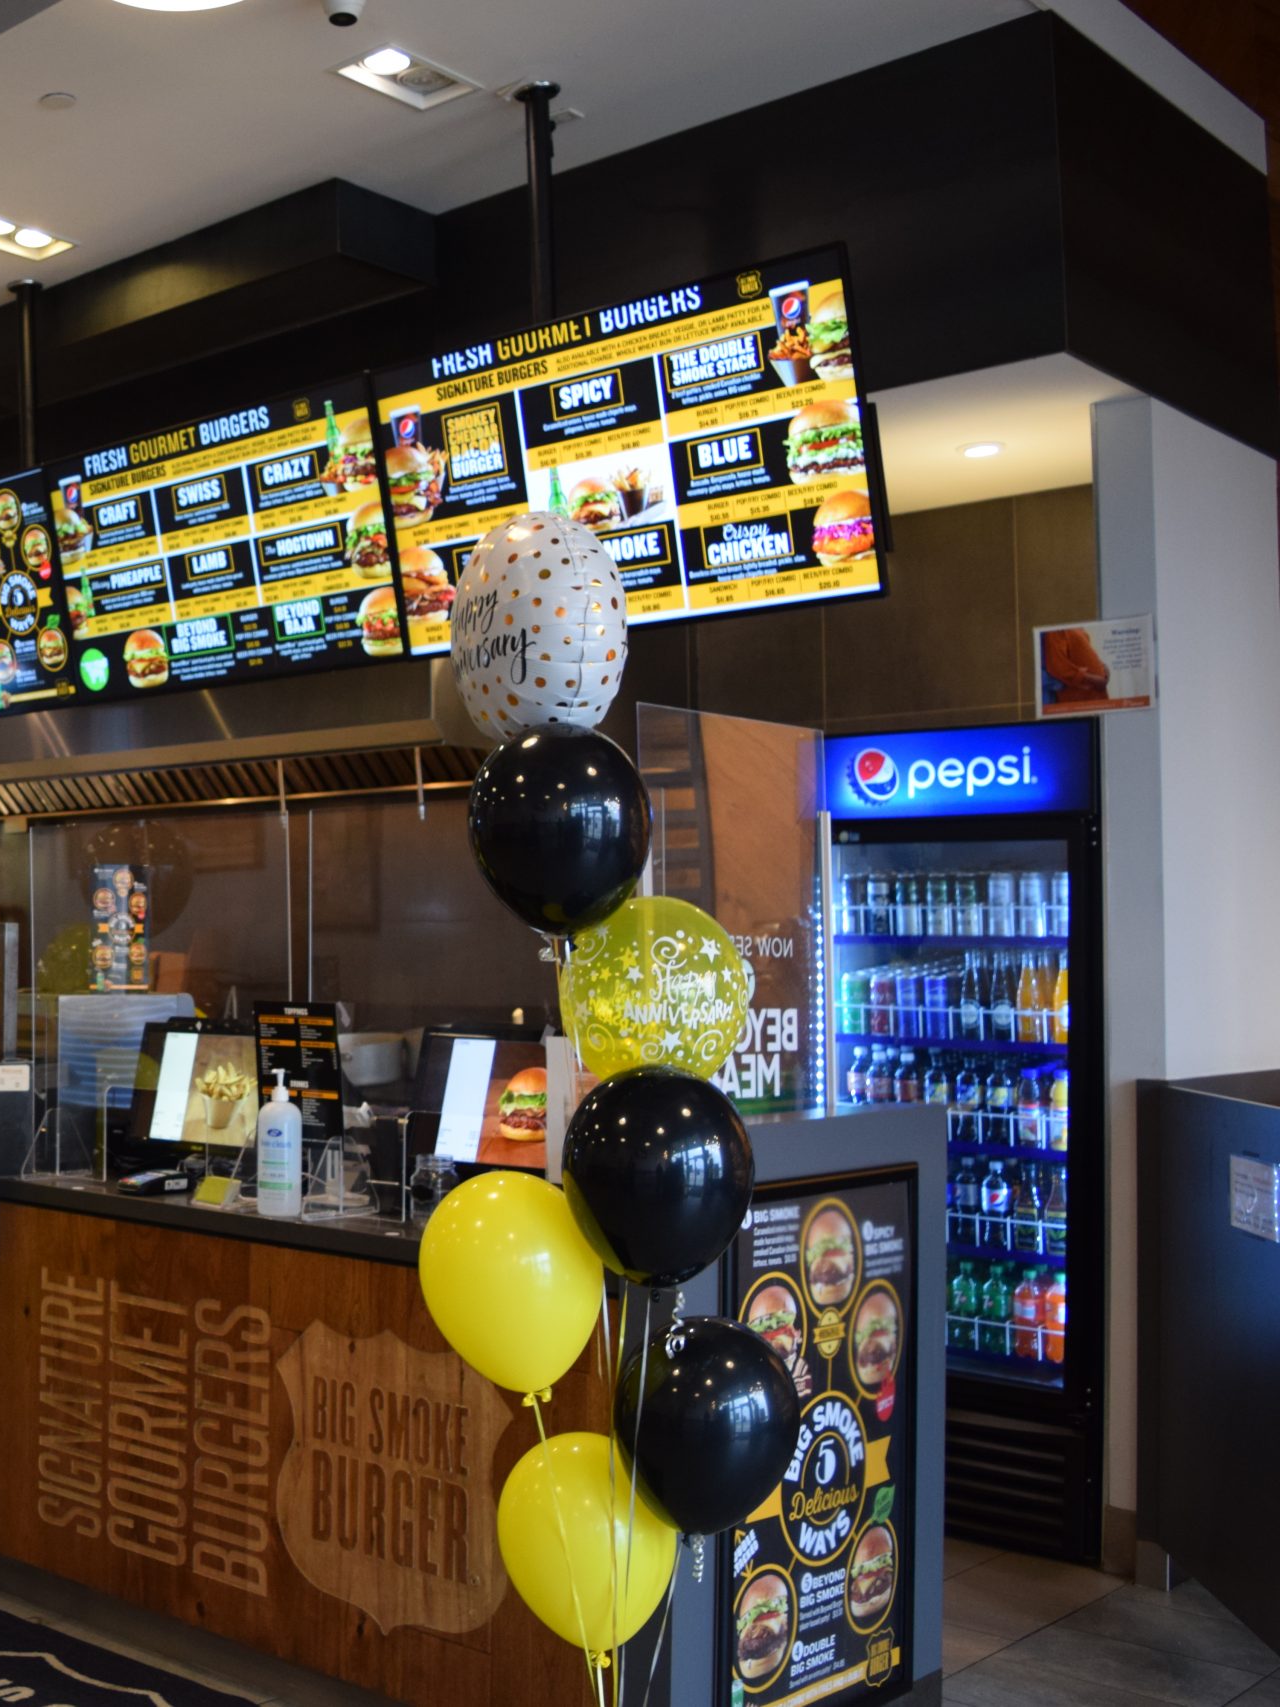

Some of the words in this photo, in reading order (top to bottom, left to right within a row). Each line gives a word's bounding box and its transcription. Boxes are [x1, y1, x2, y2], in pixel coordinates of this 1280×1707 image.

[431, 343, 493, 379] FRESH
[497, 316, 592, 360] GOURMET
[599, 286, 702, 334] BURGERS
[670, 352, 699, 371] THE
[700, 335, 755, 365] DOUBLE
[436, 374, 495, 401] SIGNATURE
[497, 360, 548, 386] BURGERS
[673, 362, 716, 386] SMOKE
[717, 352, 757, 376] STACK
[559, 375, 613, 410] SPICY
[750, 395, 770, 405] COMBO
[805, 383, 826, 393] COMBO
[447, 408, 497, 434] SMOKEY
[84, 446, 128, 477] FRESH
[129, 426, 196, 464] GOURMET
[199, 405, 270, 446] BURGERS
[697, 435, 752, 469] BLUE
[89, 474, 129, 495] SIGNATURE
[131, 465, 166, 486] BURGERS
[262, 456, 311, 486] CRAZY
[451, 452, 504, 480] BURGER
[177, 479, 221, 507] SWISS
[761, 491, 782, 501] COMBO
[816, 481, 838, 492] COMBO
[98, 500, 136, 527] CRAFT
[276, 529, 335, 557] HOGTOWN
[602, 532, 661, 562] MOKE
[723, 523, 770, 542] Crispy
[191, 551, 227, 574] LAMB
[707, 532, 790, 566] CHICKEN
[110, 565, 162, 590] PINEAPPLE
[776, 573, 796, 583] COMBO
[832, 566, 853, 576] COMBO
[10, 613, 35, 632] WAYS
[275, 600, 320, 622] BEYOND
[284, 617, 316, 635] BAJA
[171, 637, 190, 654] BIG
[191, 630, 227, 652] SMOKE
[176, 618, 218, 638] BEYOND
[907, 745, 1032, 800] pepsi
[649, 964, 718, 1004] Happy
[754, 1208, 770, 1224] BIG
[770, 1205, 801, 1221] SMOKE
[37, 1266, 105, 1539] SIGNATURE
[106, 1279, 189, 1568] GOURMET
[312, 1374, 356, 1448] BIG
[369, 1386, 470, 1478] SMOKE
[192, 1297, 272, 1598] BURGERS
[784, 1423, 814, 1483] BIG
[812, 1401, 865, 1468] SMOKE
[815, 1438, 836, 1486] 5
[311, 1447, 471, 1586] BURGER
[789, 1483, 860, 1522] Delicious
[798, 1508, 851, 1557] WAYS
[812, 1568, 846, 1589] BEYOND
[800, 1593, 815, 1609] BIG
[816, 1582, 846, 1604] SMOKE
[803, 1634, 837, 1658] DOUBLE
[790, 1662, 805, 1678] BIG
[805, 1648, 836, 1671] SMOKE
